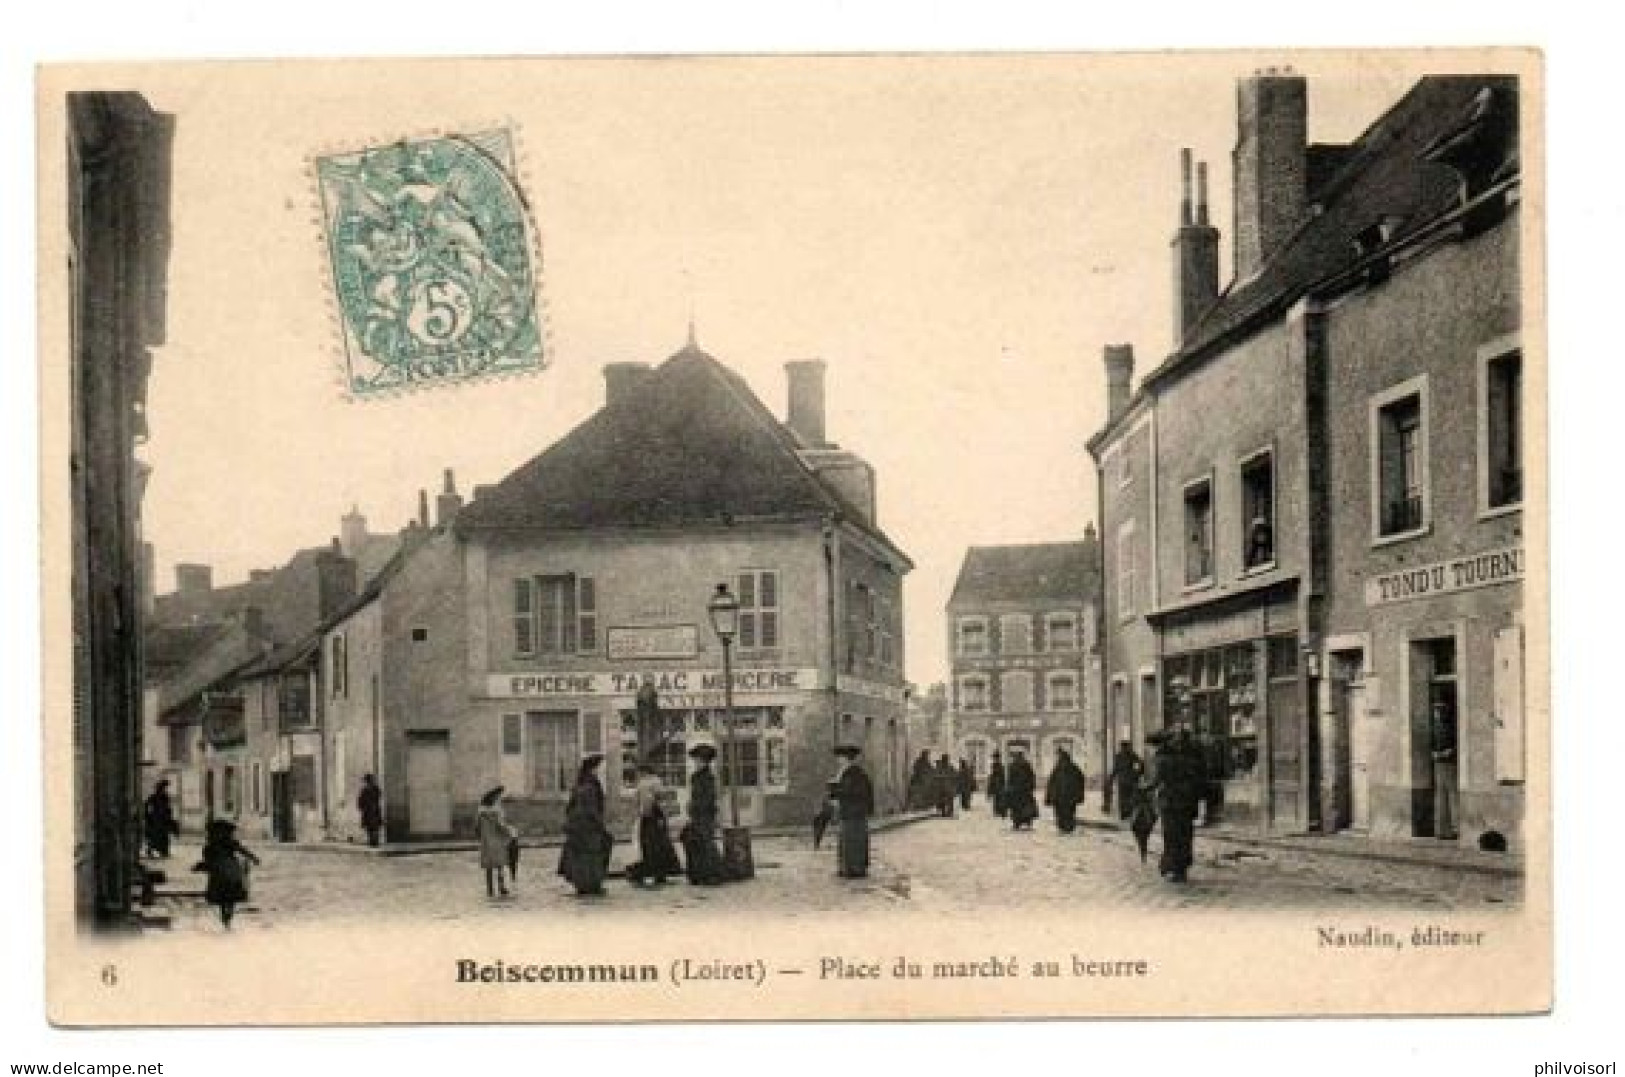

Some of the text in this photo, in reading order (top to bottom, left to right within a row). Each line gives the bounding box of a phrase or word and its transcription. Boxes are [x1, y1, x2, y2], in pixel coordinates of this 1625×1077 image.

[1379, 565, 1444, 599] TONDU
[510, 670, 799, 693] EPICERIE TABAC MERCERIE
[1317, 925, 1485, 949] Naudin, éditeur
[101, 964, 118, 986] 6
[670, 958, 766, 987] (Loiret)
[819, 956, 880, 980] Place
[892, 956, 923, 979] du
[933, 955, 1017, 979] marché
[1031, 961, 1060, 977] au
[1072, 956, 1148, 978] beurre
